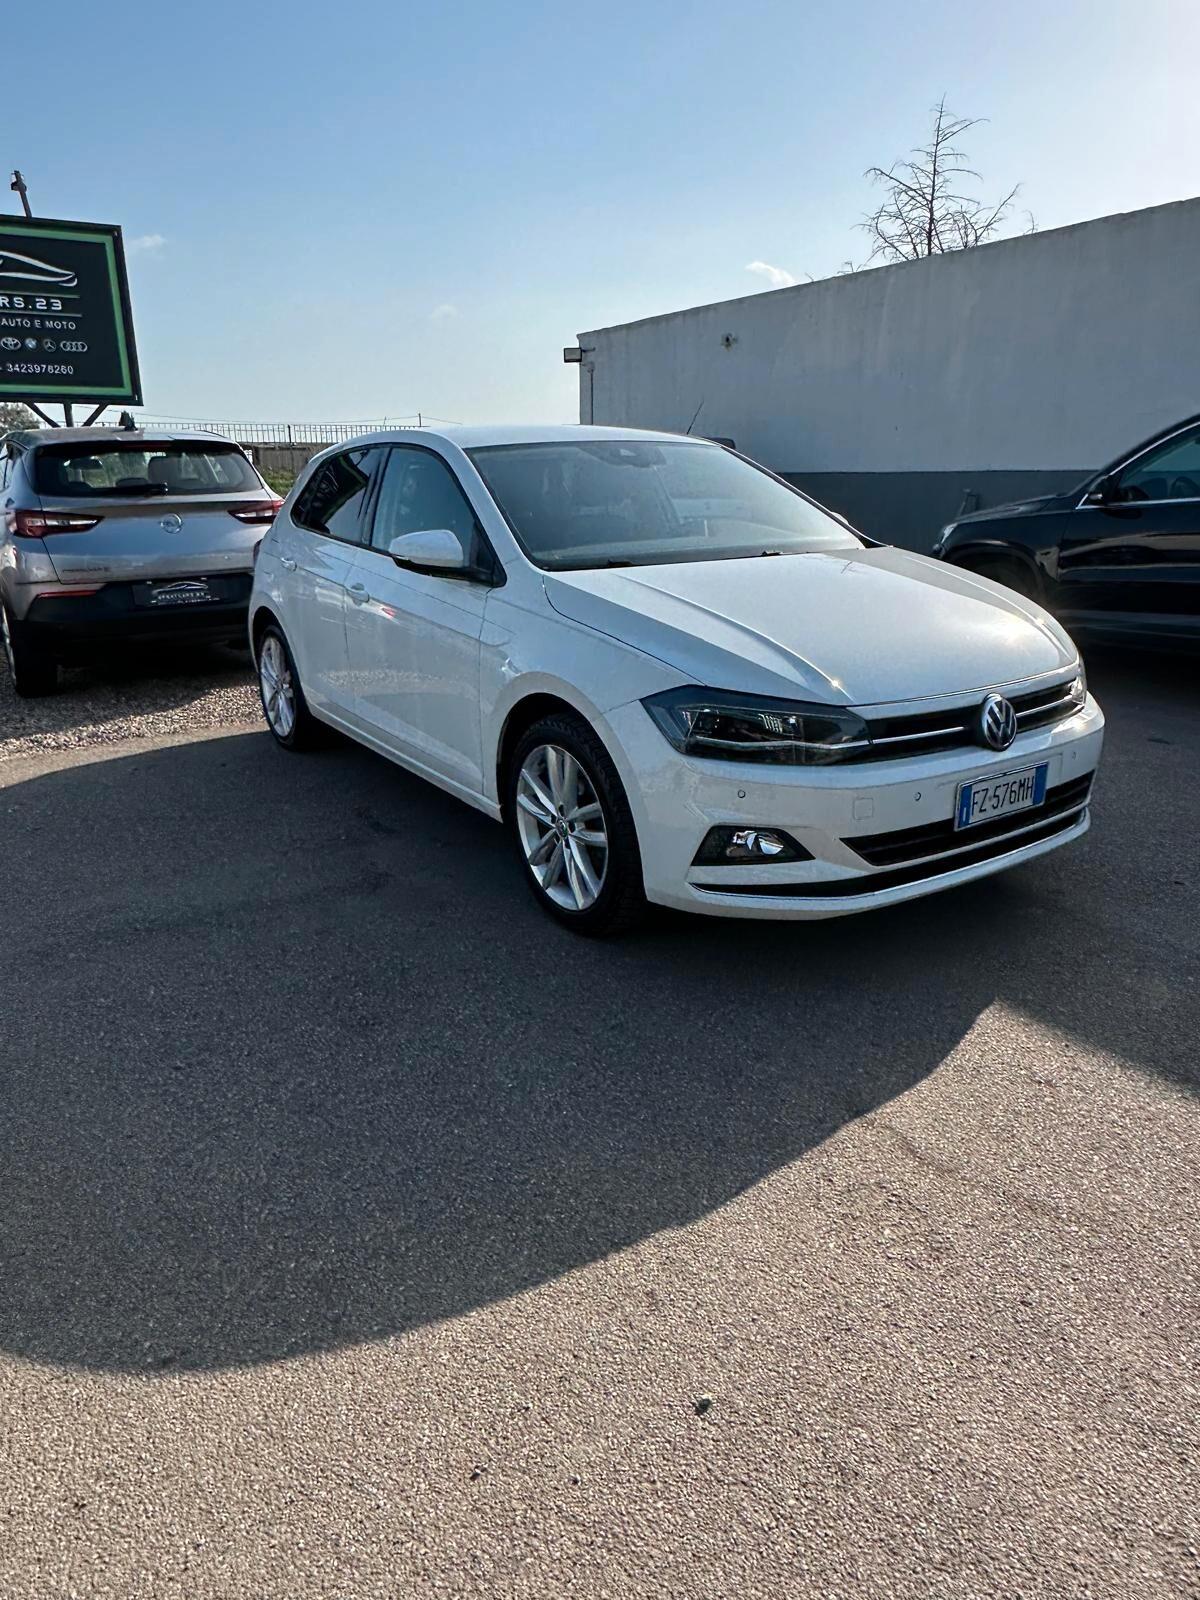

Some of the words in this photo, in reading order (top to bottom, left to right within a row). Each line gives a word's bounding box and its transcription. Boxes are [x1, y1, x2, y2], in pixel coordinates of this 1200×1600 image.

[1, 318, 31, 328] AUTO
[34, 319, 42, 329] E
[45, 320, 76, 330] MOTO
